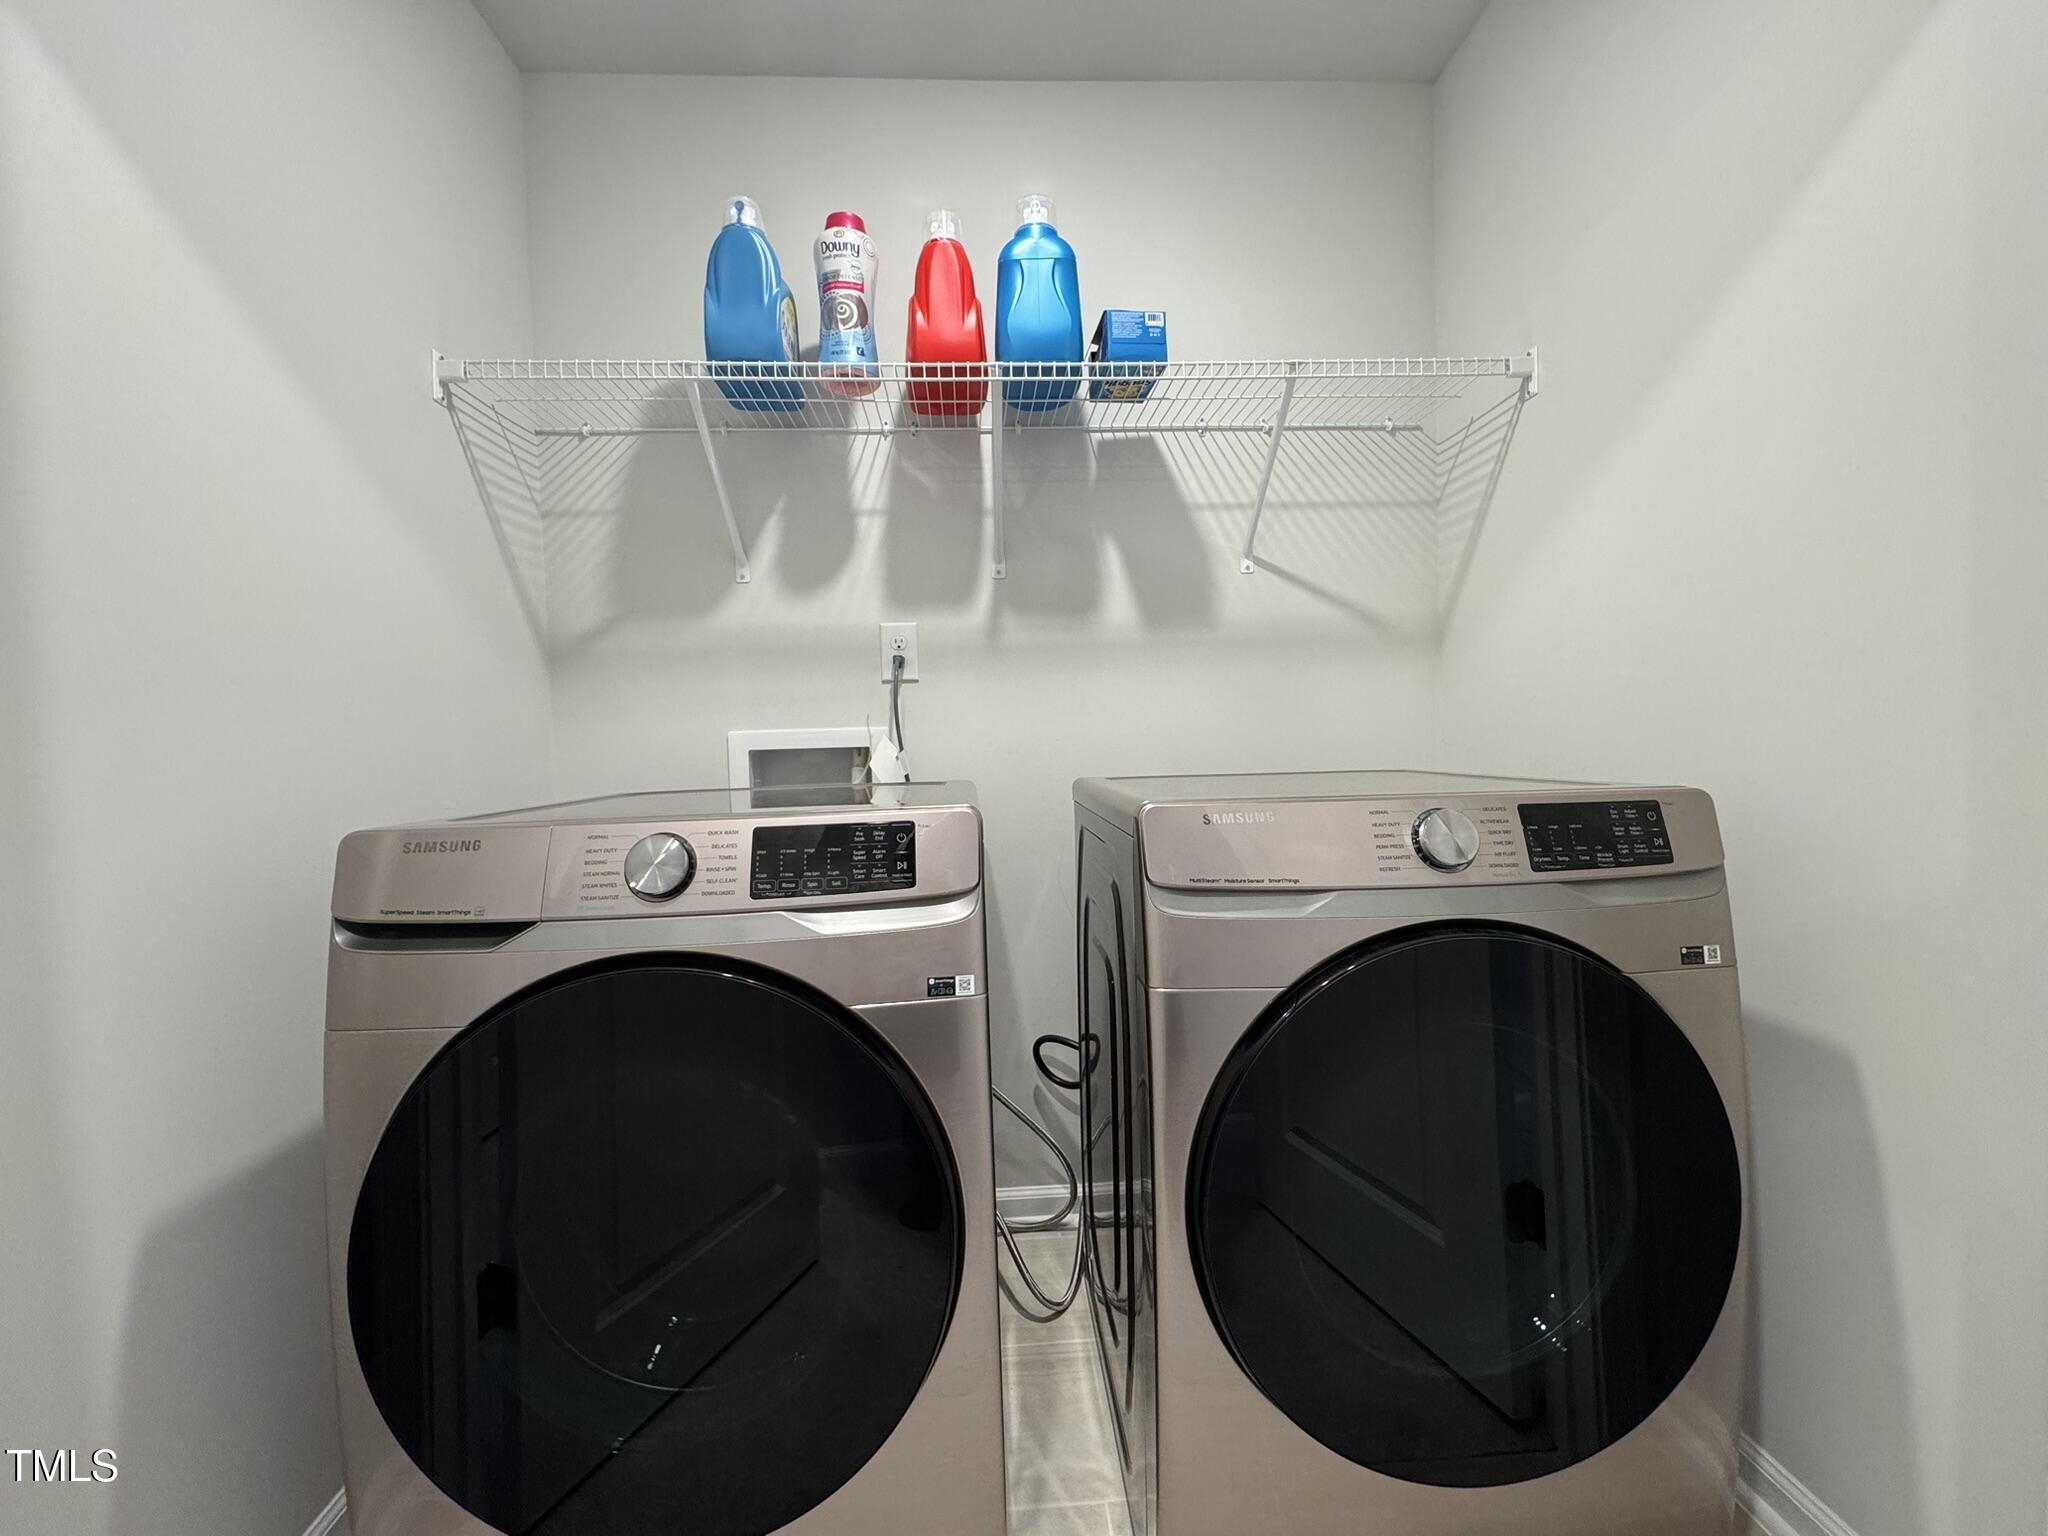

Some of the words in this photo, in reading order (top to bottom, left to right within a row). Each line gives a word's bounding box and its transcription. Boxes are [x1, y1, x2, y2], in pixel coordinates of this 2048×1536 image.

[821, 241, 860, 258] Downy
[1203, 811, 1274, 825] SAMSUNG
[403, 840, 481, 854] SAMSUNG
